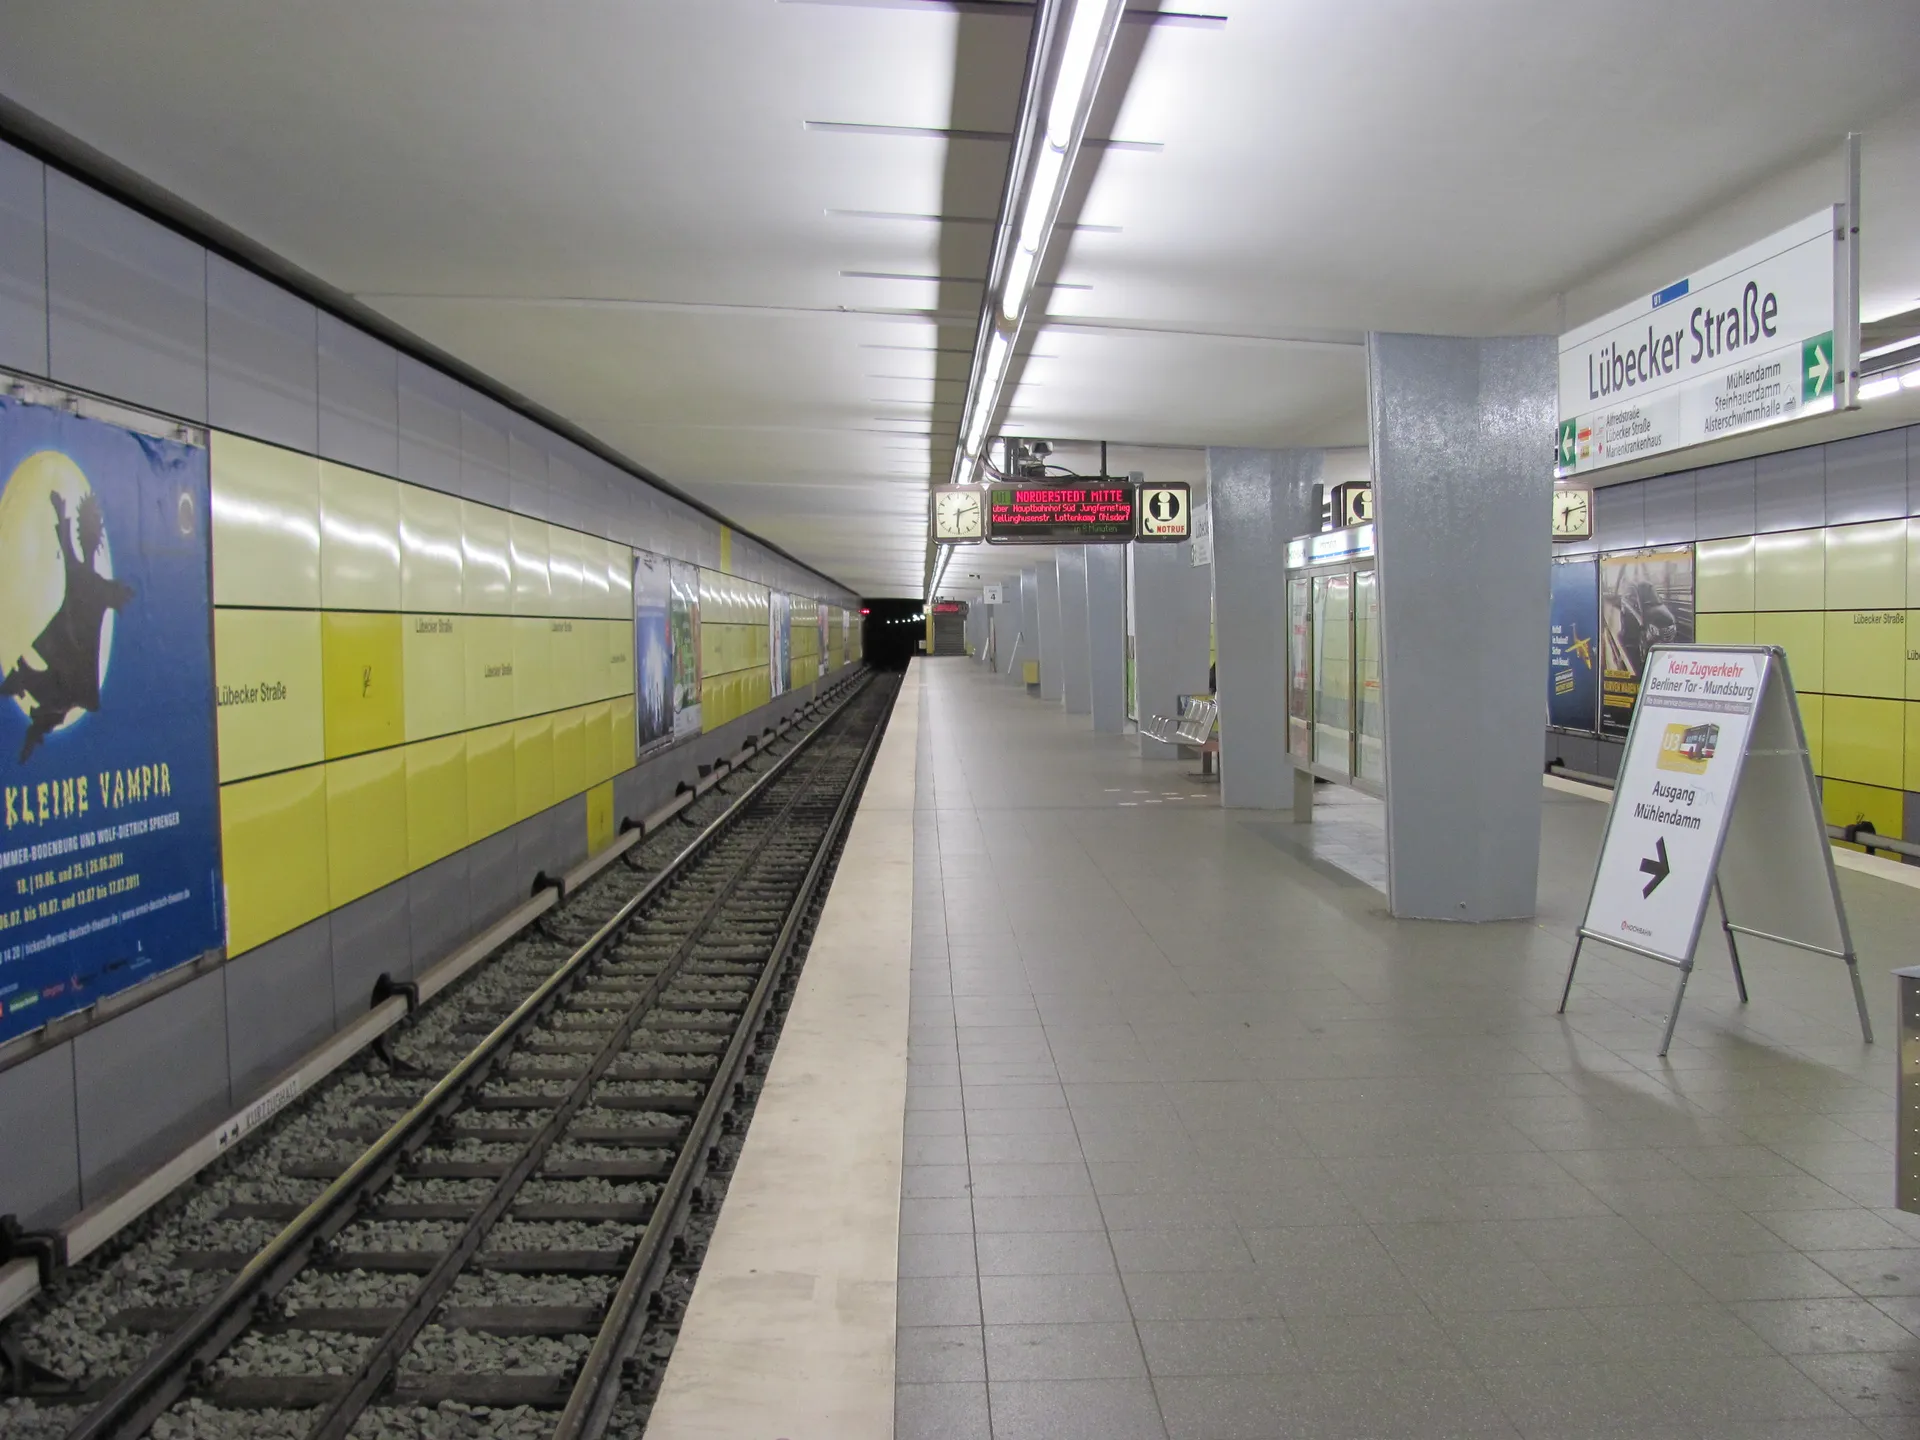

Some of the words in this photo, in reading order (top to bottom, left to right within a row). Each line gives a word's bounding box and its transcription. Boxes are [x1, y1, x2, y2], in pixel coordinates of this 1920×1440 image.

[1589, 325, 1684, 400] Lübecker
[1690, 281, 1778, 364] Straße
[1727, 363, 1780, 390] Mühlendamm
[1715, 383, 1780, 412] Steinhauerdamm
[1704, 399, 1780, 433] Alsterschwimmhalle
[1606, 425, 1631, 443] Lübecker
[1632, 418, 1651, 436] Straße
[1606, 434, 1662, 459] Marienkrankenhaus
[993, 504, 1009, 512] über
[1012, 504, 1061, 514] Hauptbahnhof
[1062, 504, 1076, 512] Süd
[1080, 503, 1131, 514] Jungfernstieg
[1016, 490, 1086, 502] NORDERSTEDT
[1091, 490, 1123, 502] MITTE
[993, 513, 1053, 524] Kellinghusenstr.
[1099, 513, 1129, 522] Ohlsdorf
[1089, 523, 1118, 533] Minuten
[1156, 525, 1185, 533] NOTRUF
[1853, 613, 1882, 624] Lübecker
[1883, 613, 1905, 624] Straße
[1668, 661, 1688, 675] Kein
[1689, 661, 1744, 679] Zugverkehr
[216, 684, 259, 706] Lübecker
[260, 681, 287, 702] Straße
[1650, 677, 1684, 692] Berliner
[1684, 679, 1698, 693] Tor
[1703, 680, 1755, 701] Mundsburg
[1663, 731, 1681, 752] U3
[5, 776, 88, 830] KLEINE
[100, 763, 170, 809] VAMPIR
[1652, 781, 1695, 806] Ausgang
[1634, 802, 1701, 830] Mühlendamm
[80, 831, 96, 848] UND
[97, 819, 149, 844] WOLF-DIETRICH
[149, 811, 180, 832] SPRENGER
[24, 905, 36, 922] bis
[62, 892, 75, 911] und
[97, 884, 107, 899] bis
